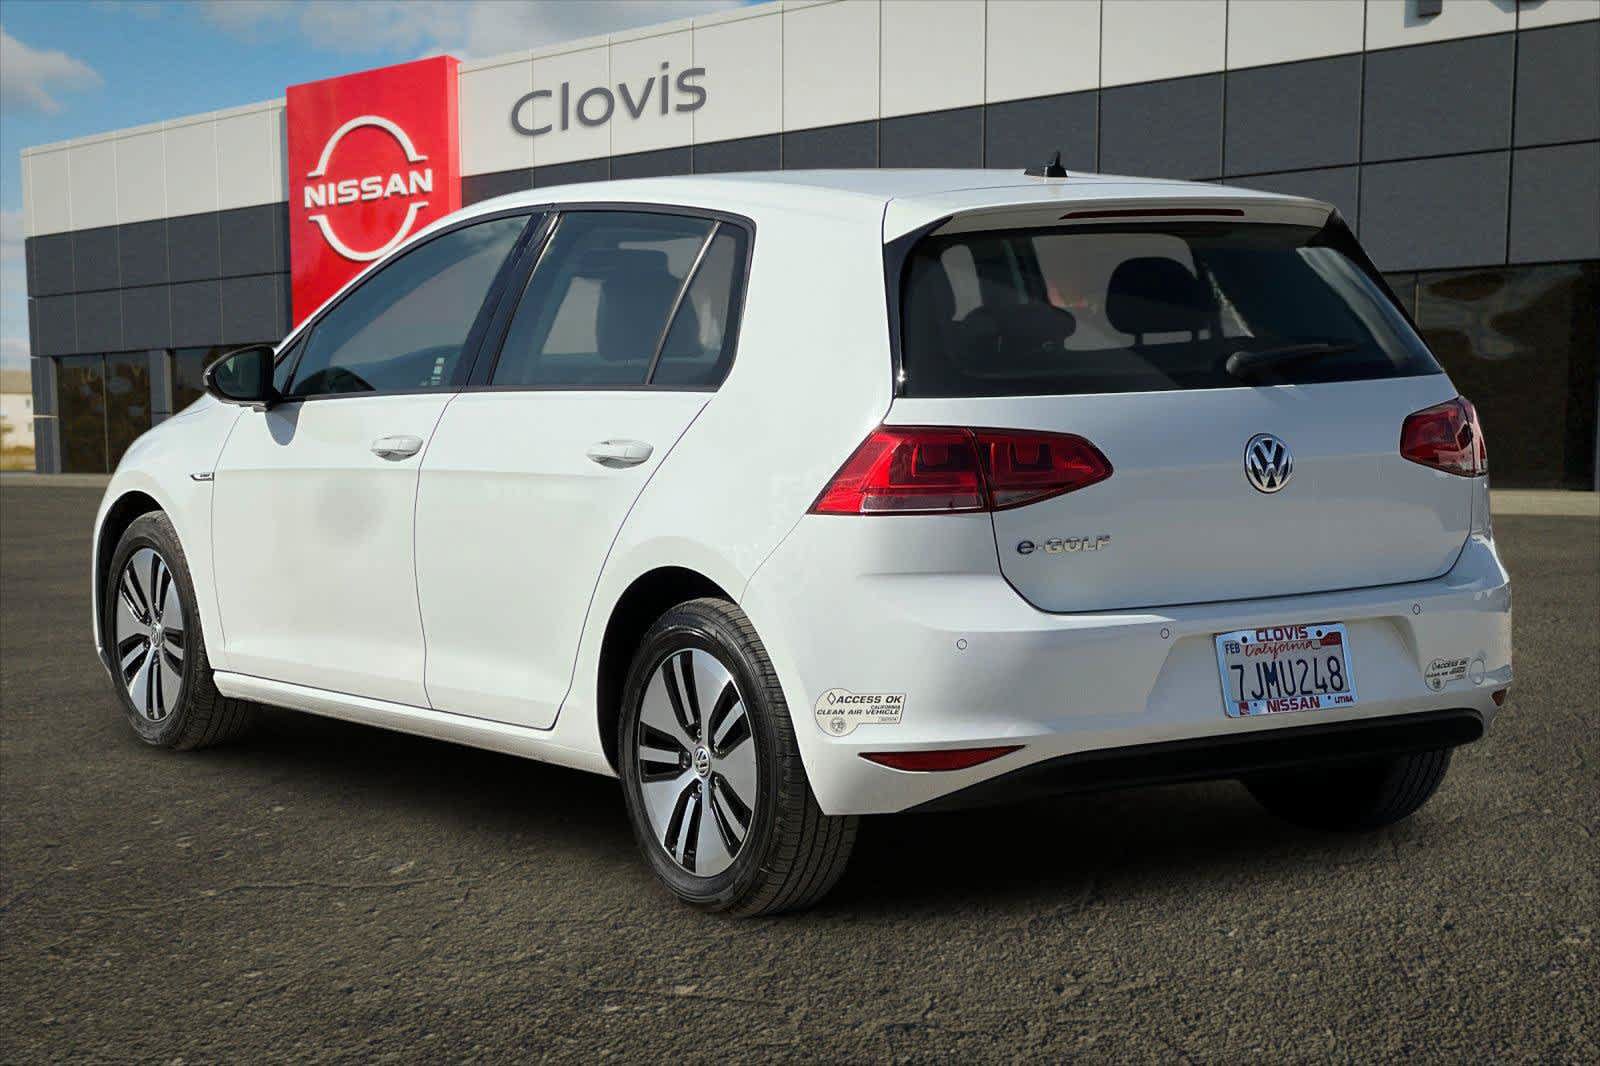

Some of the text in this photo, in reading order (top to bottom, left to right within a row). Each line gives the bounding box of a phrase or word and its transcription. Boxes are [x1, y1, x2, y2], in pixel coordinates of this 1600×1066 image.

[511, 61, 708, 136] Clovis
[304, 168, 433, 209] NISSAN
[1255, 626, 1308, 642] CLOVIS
[1225, 642, 1240, 655] FEB
[1244, 640, 1314, 659] California
[1230, 655, 1344, 702] 7JMU248
[836, 695, 903, 704] ACCESS OK
[1266, 696, 1321, 713] NISSAN
